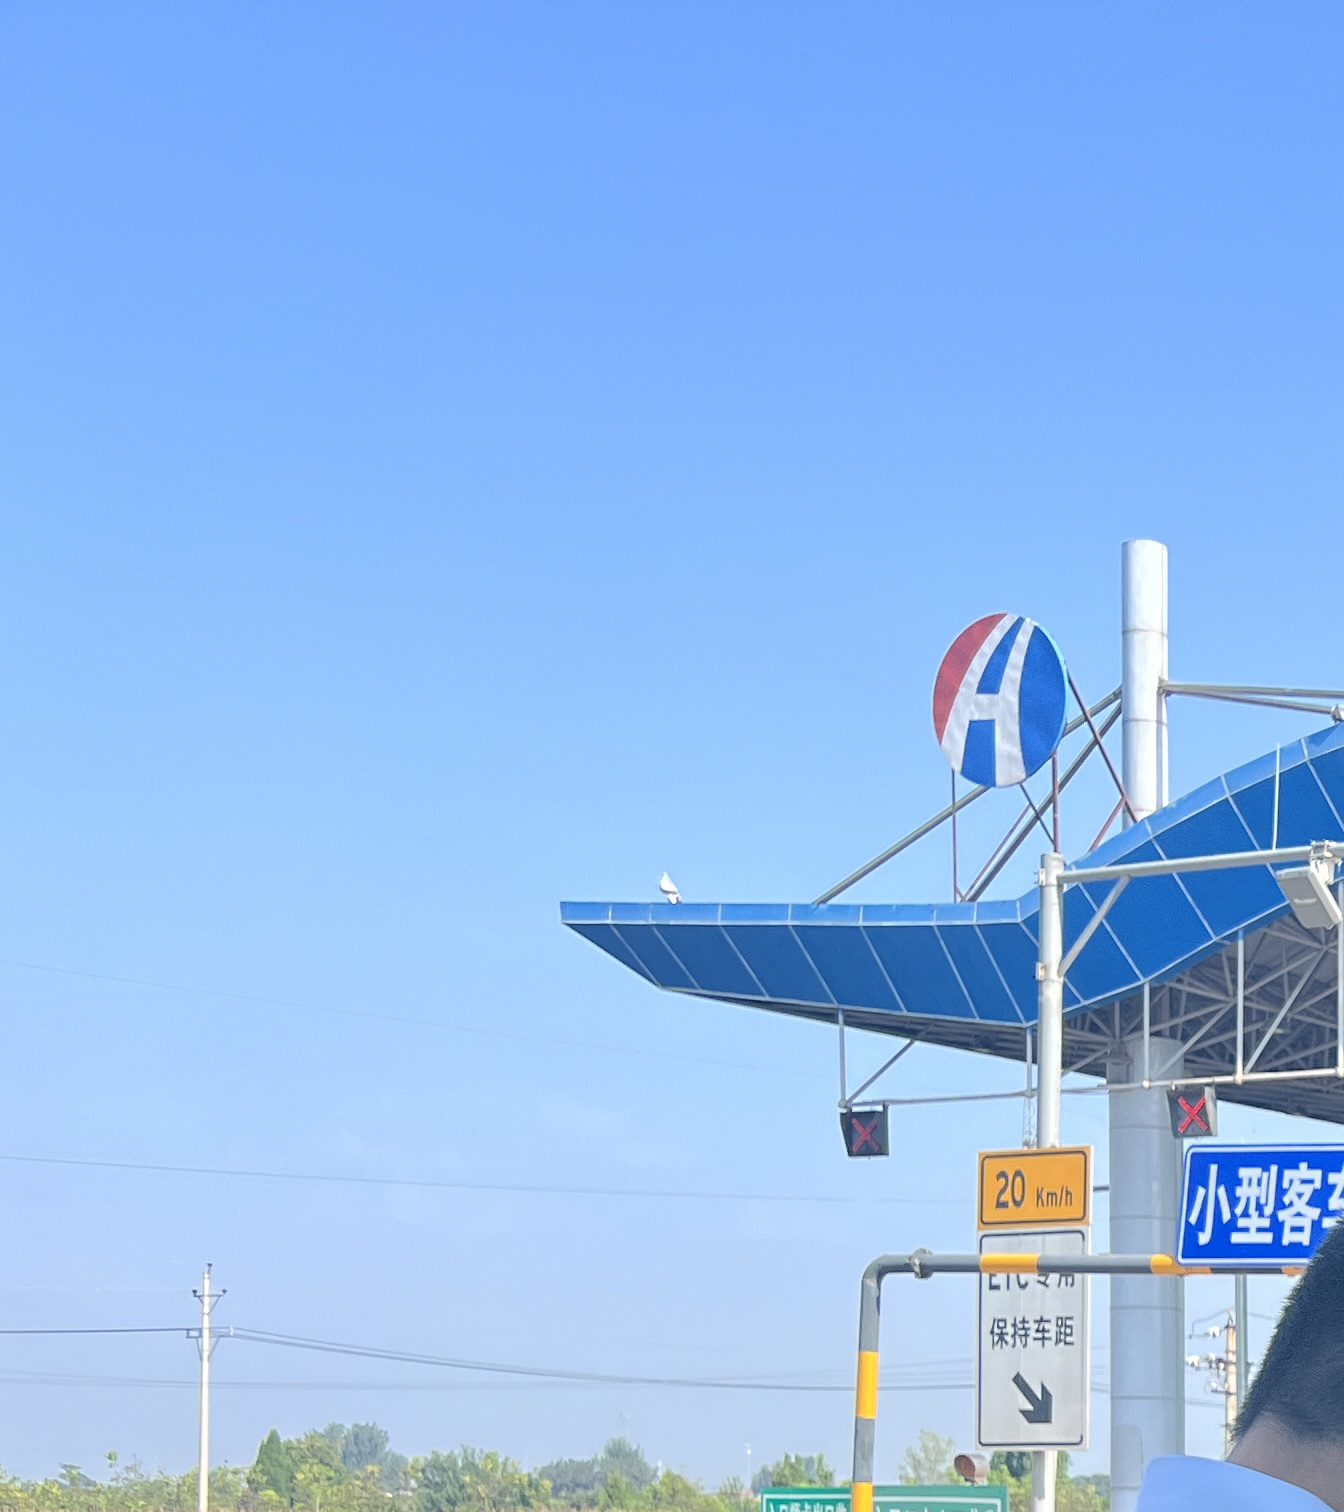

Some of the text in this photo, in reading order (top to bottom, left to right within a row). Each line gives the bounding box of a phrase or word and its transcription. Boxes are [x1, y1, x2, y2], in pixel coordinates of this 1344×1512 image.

[995, 1169, 1074, 1209] 20 Km/h
[989, 1315, 1075, 1350] 保持车距
